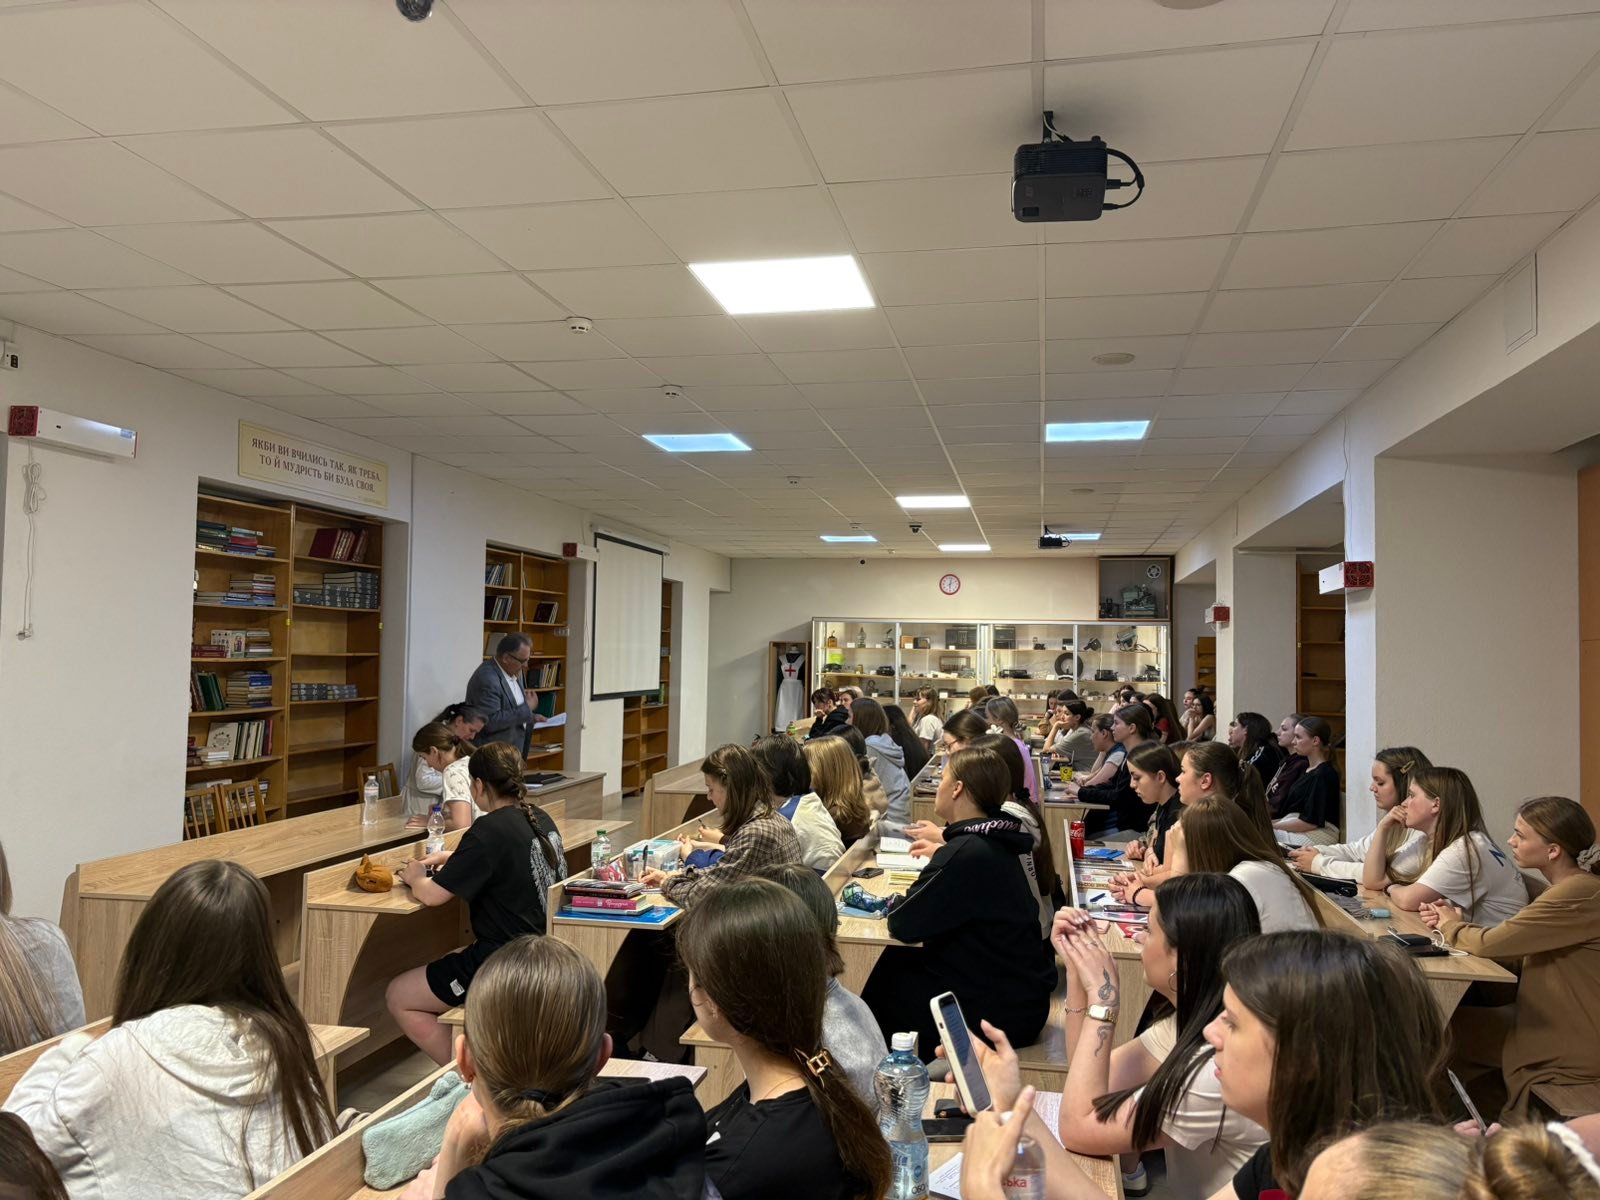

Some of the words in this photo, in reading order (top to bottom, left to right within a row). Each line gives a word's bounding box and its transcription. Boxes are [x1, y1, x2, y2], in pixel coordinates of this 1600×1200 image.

[251, 438, 276, 453] ЯКБИ
[278, 445, 289, 456] ВИ
[291, 448, 327, 467] ВЧИЛИСЬ
[347, 464, 358, 476] ЯК
[260, 454, 272, 466] ТО
[274, 455, 281, 469] Й
[283, 460, 322, 479] МУДРІСТЬ
[324, 470, 334, 482] БИ
[336, 474, 354, 488] БУЛА
